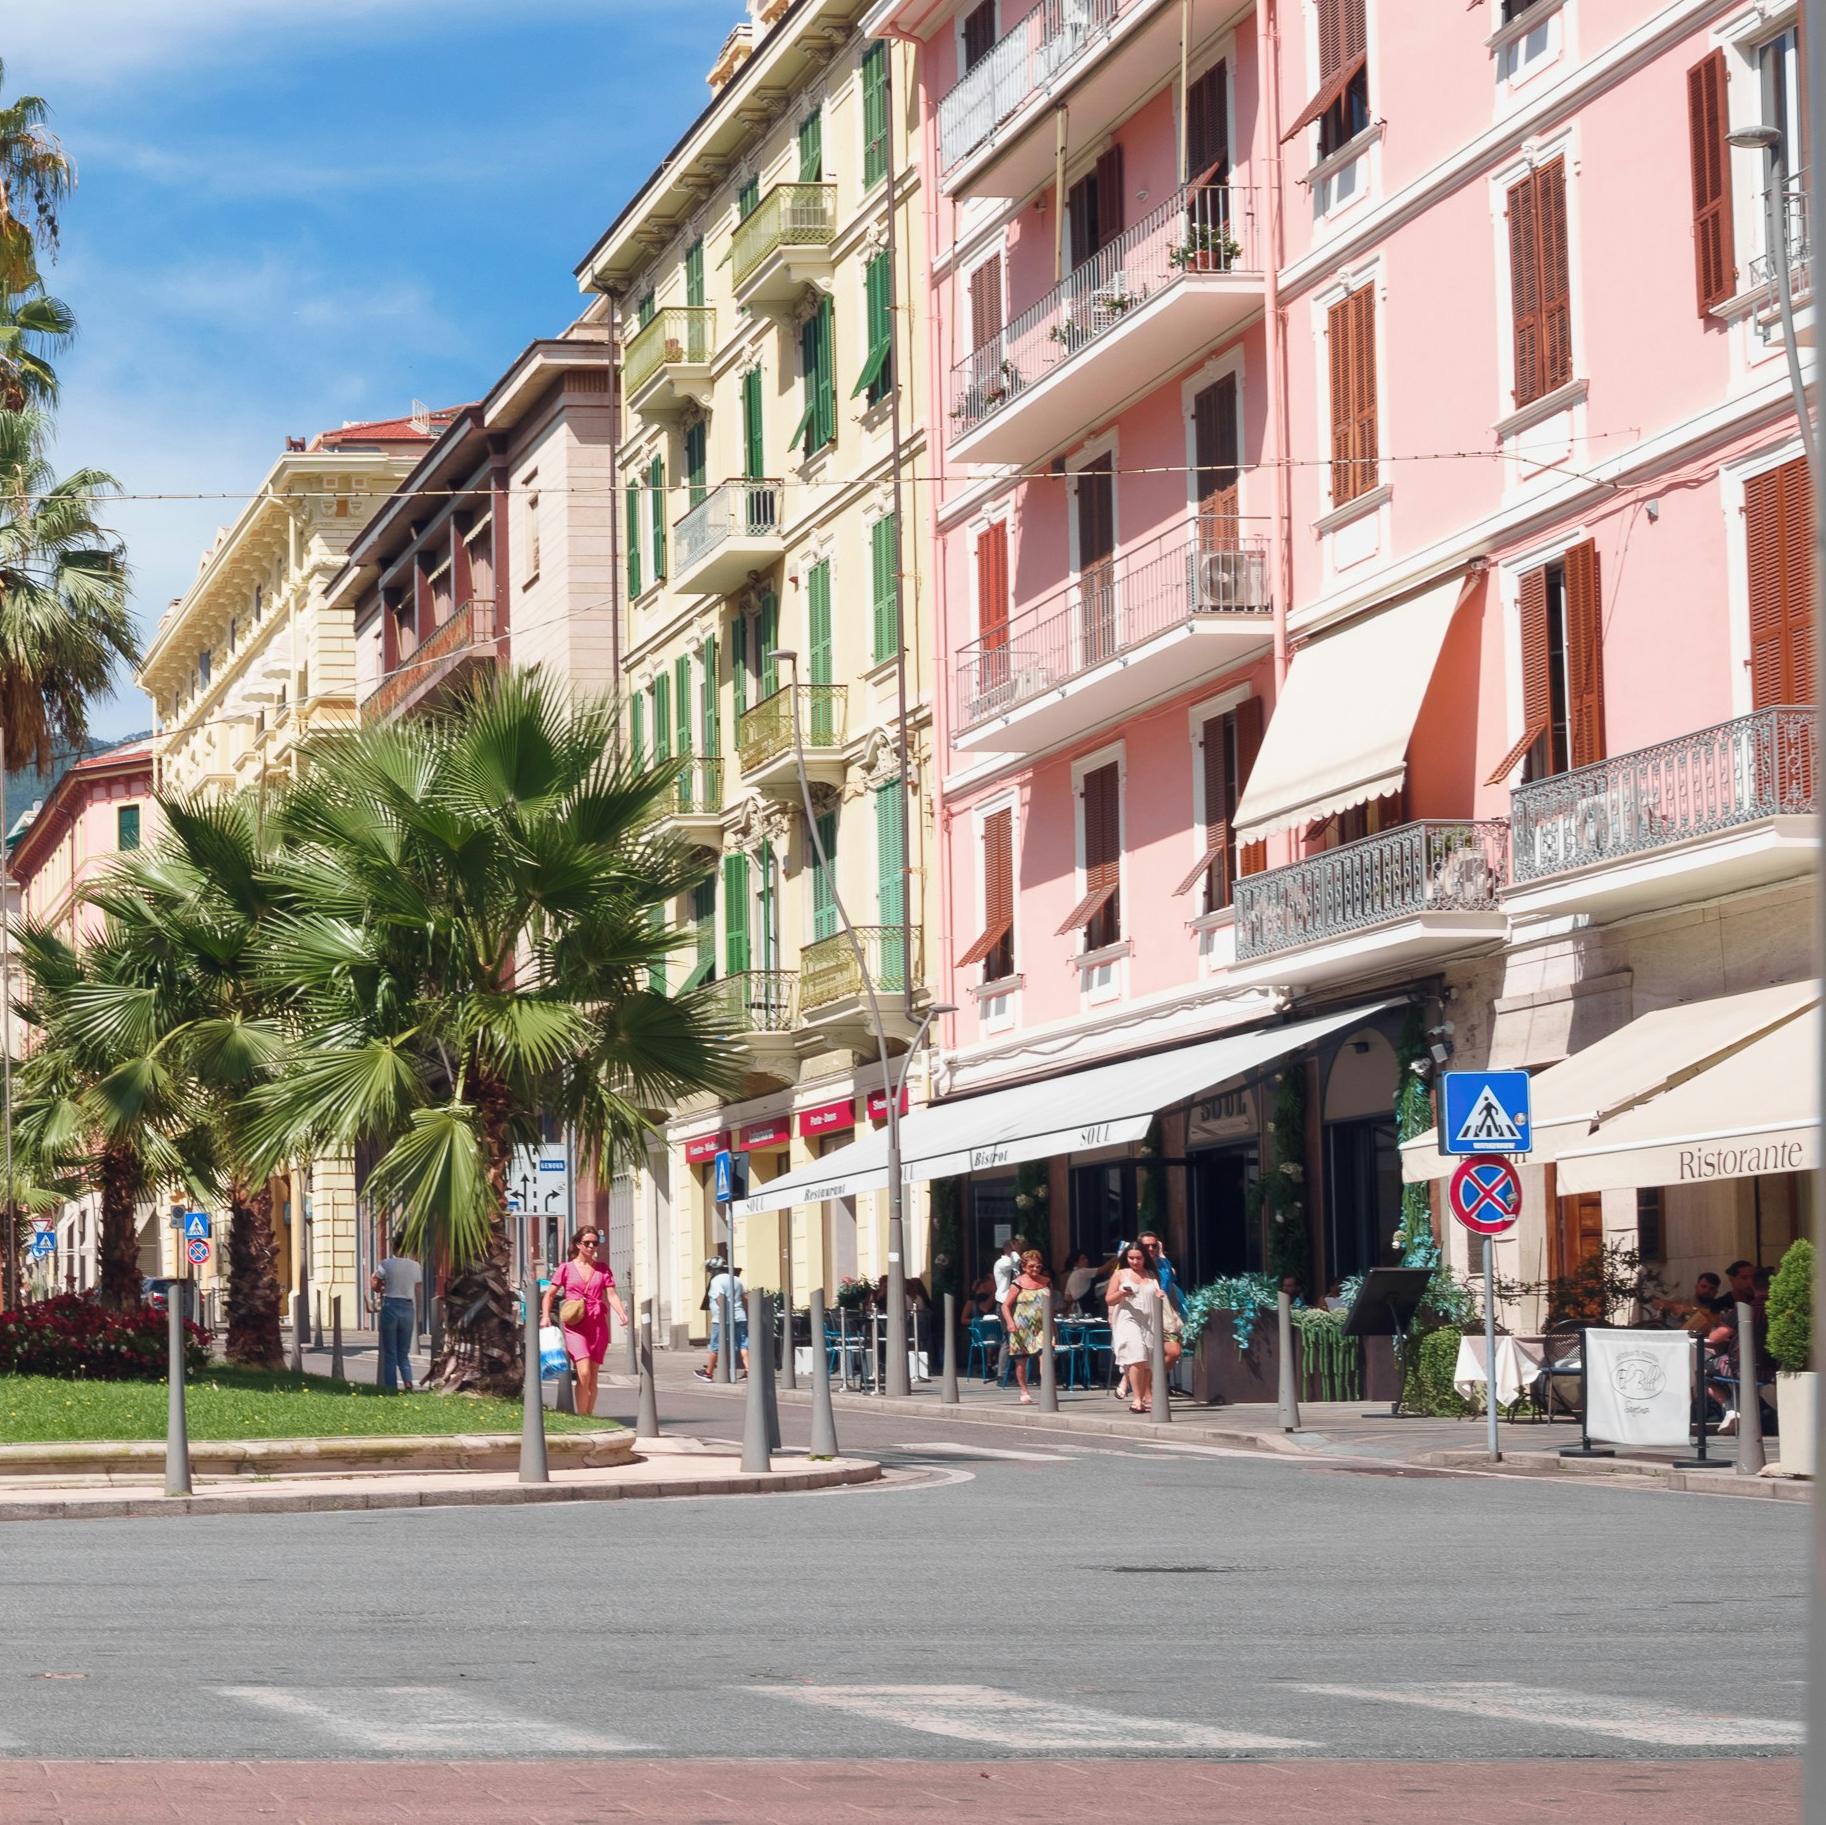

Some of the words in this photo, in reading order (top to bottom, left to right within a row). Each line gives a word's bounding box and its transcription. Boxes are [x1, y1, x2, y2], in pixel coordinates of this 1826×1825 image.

[1080, 1124, 1110, 1147] SOUL
[974, 1149, 1008, 1167] Bistrot
[1679, 1140, 1803, 1180] Ristorante
[804, 1183, 846, 1201] Restaurant
